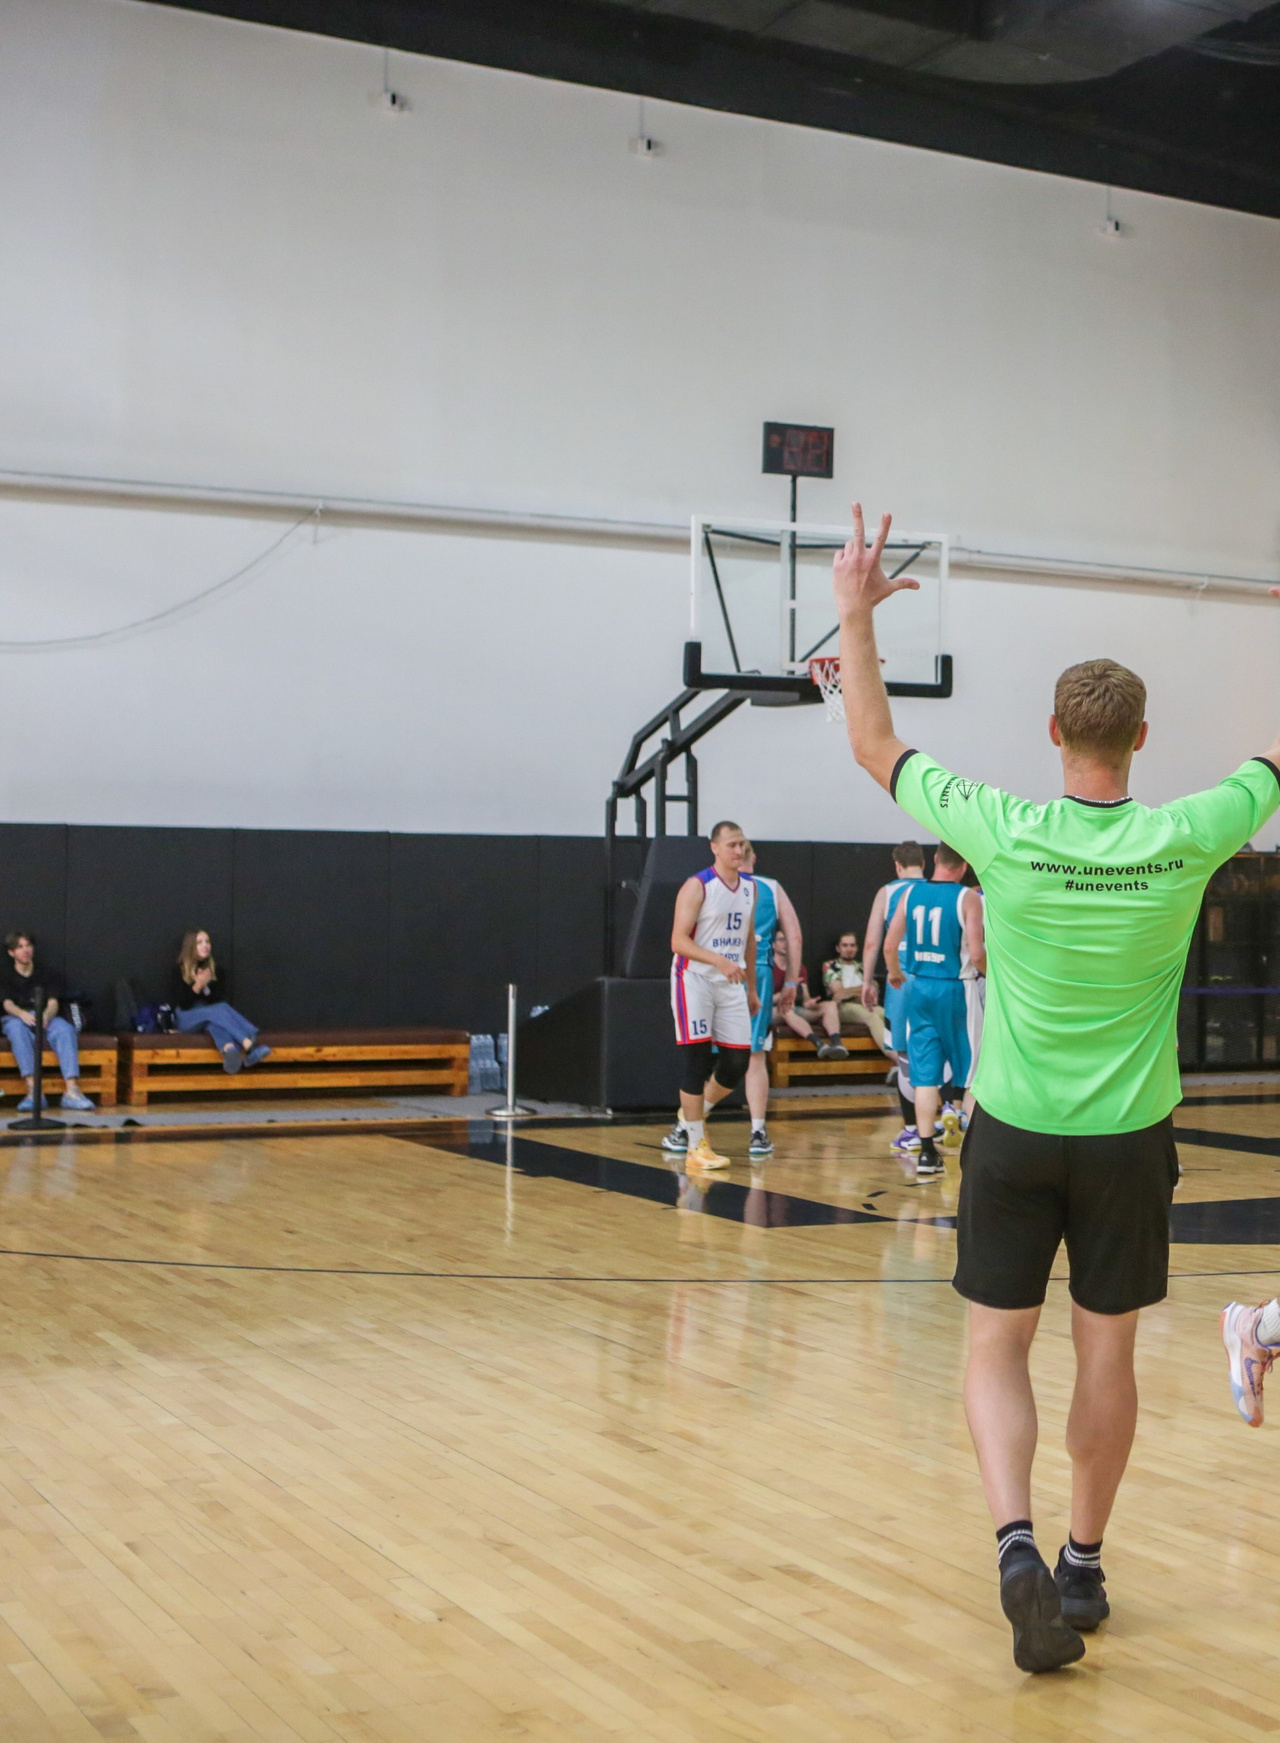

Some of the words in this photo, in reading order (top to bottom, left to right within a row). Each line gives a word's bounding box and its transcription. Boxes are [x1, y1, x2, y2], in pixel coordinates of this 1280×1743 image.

[1030, 859, 1184, 876] www.unevents.ru
[1065, 879, 1149, 892] #unevents
[726, 912, 742, 930] 15
[912, 904, 942, 947] 11
[692, 1019, 708, 1036] 15
